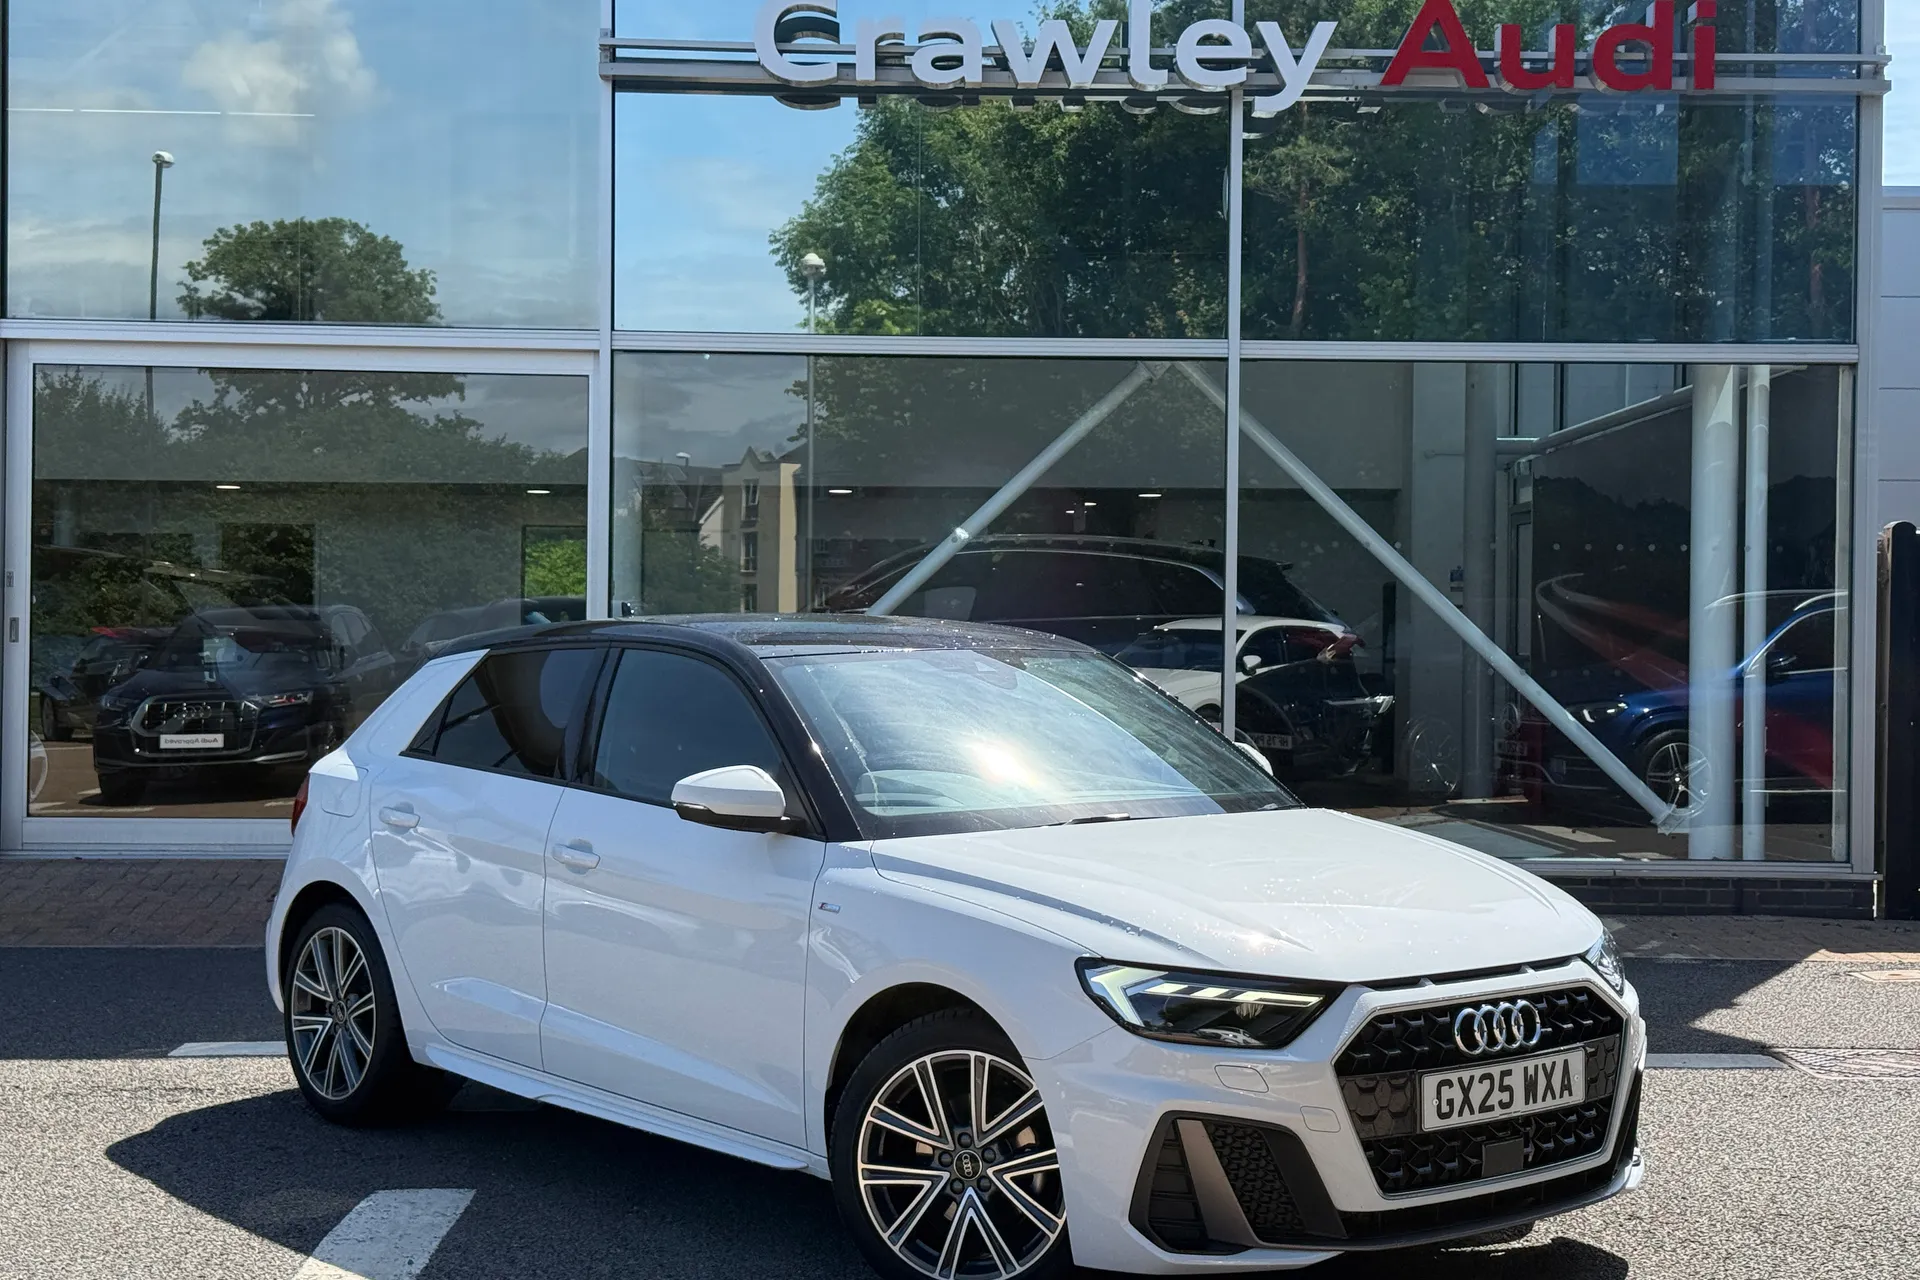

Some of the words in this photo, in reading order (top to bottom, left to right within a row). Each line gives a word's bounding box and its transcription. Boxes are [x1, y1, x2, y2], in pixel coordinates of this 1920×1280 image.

[754, 0, 1338, 114] Crawley
[1379, 0, 1717, 92] Audi
[1436, 1068, 1515, 1120] GX25
[1523, 1058, 1573, 1107] WXA
